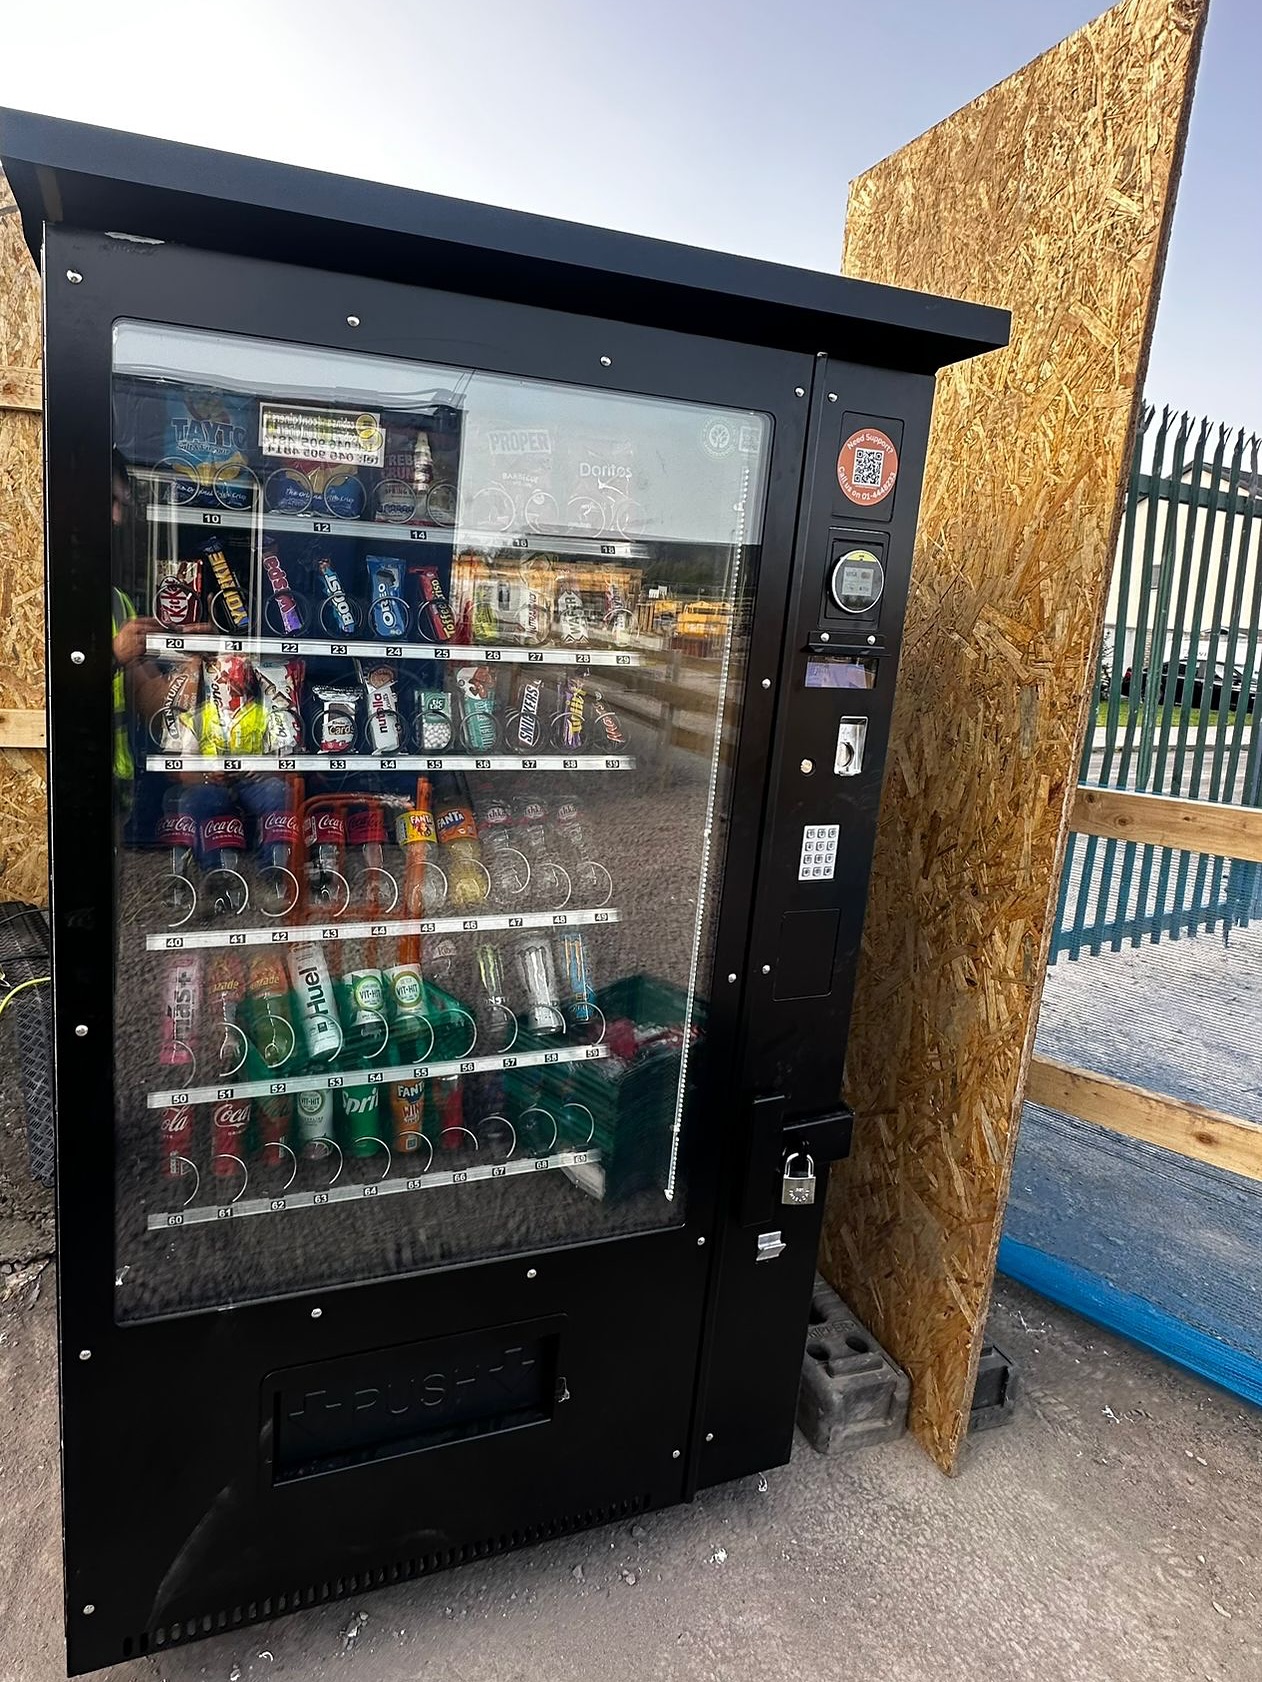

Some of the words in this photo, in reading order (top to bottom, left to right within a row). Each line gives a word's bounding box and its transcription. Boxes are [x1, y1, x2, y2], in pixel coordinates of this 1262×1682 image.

[171, 417, 248, 449] TAYTO
[491, 431, 548, 451] PROPER
[847, 434, 865, 450] Need
[865, 433, 894, 454] Support?
[580, 462, 633, 478] Doritos
[839, 466, 847, 483] Call
[844, 483, 852, 493] us
[851, 490, 861, 499] on
[204, 514, 220, 524] 10
[315, 523, 330, 532] 12
[411, 531, 426, 540] 14
[263, 556, 296, 613] Wspa
[208, 552, 248, 627] YORKIE
[324, 573, 355, 626] BOOST
[378, 583, 396, 627] OREO
[166, 639, 183, 648] 20
[226, 642, 240, 650] 21
[282, 644, 298, 652] 22
[332, 645, 347, 654] 23
[387, 648, 402, 656] 24
[435, 650, 449, 658] 25
[486, 651, 500, 659] 26
[529, 653, 543, 661] 27
[576, 654, 590, 662] 28
[617, 656, 630, 664] 29
[372, 693, 388, 734] nutella
[519, 685, 539, 743] SNICKERS
[166, 760, 182, 769] 30
[225, 760, 240, 769] 31
[280, 760, 294, 768] 32
[330, 760, 345, 768] 33
[381, 760, 395, 768] 34
[428, 760, 442, 768] 35
[476, 760, 490, 768] 36
[523, 760, 536, 768] 37
[564, 760, 577, 768] 38
[606, 760, 619, 768] 39
[437, 811, 464, 830] FANTA
[553, 916, 566, 924] 48
[595, 913, 608, 921] 49
[464, 921, 477, 930] 46
[509, 918, 522, 926] 47
[372, 927, 386, 935] 44
[421, 924, 435, 932] 45
[272, 932, 287, 941] 42
[323, 929, 338, 938] 43
[167, 938, 182, 947] 40
[230, 934, 246, 943] 41
[298, 966, 329, 1015] Huel
[586, 1049, 599, 1058] 59
[504, 1058, 516, 1066] 57
[461, 1063, 474, 1072] 56
[414, 1068, 428, 1077] 55
[328, 1078, 342, 1086] 53
[368, 1074, 382, 1082] 54
[271, 1084, 285, 1093] 52
[398, 1081, 424, 1097] FANT
[218, 1090, 233, 1098] 51
[172, 1094, 188, 1104] 50
[342, 1086, 379, 1116] Spri
[536, 1160, 548, 1169] 68
[493, 1167, 506, 1176] 67
[454, 1174, 466, 1182] 66
[407, 1180, 420, 1189] 65
[364, 1187, 378, 1196] 64
[314, 1195, 328, 1203] 63
[271, 1201, 285, 1210] 62
[218, 1209, 232, 1217] 61
[168, 1216, 183, 1224] 60
[354, 1364, 480, 1417] PUSH
